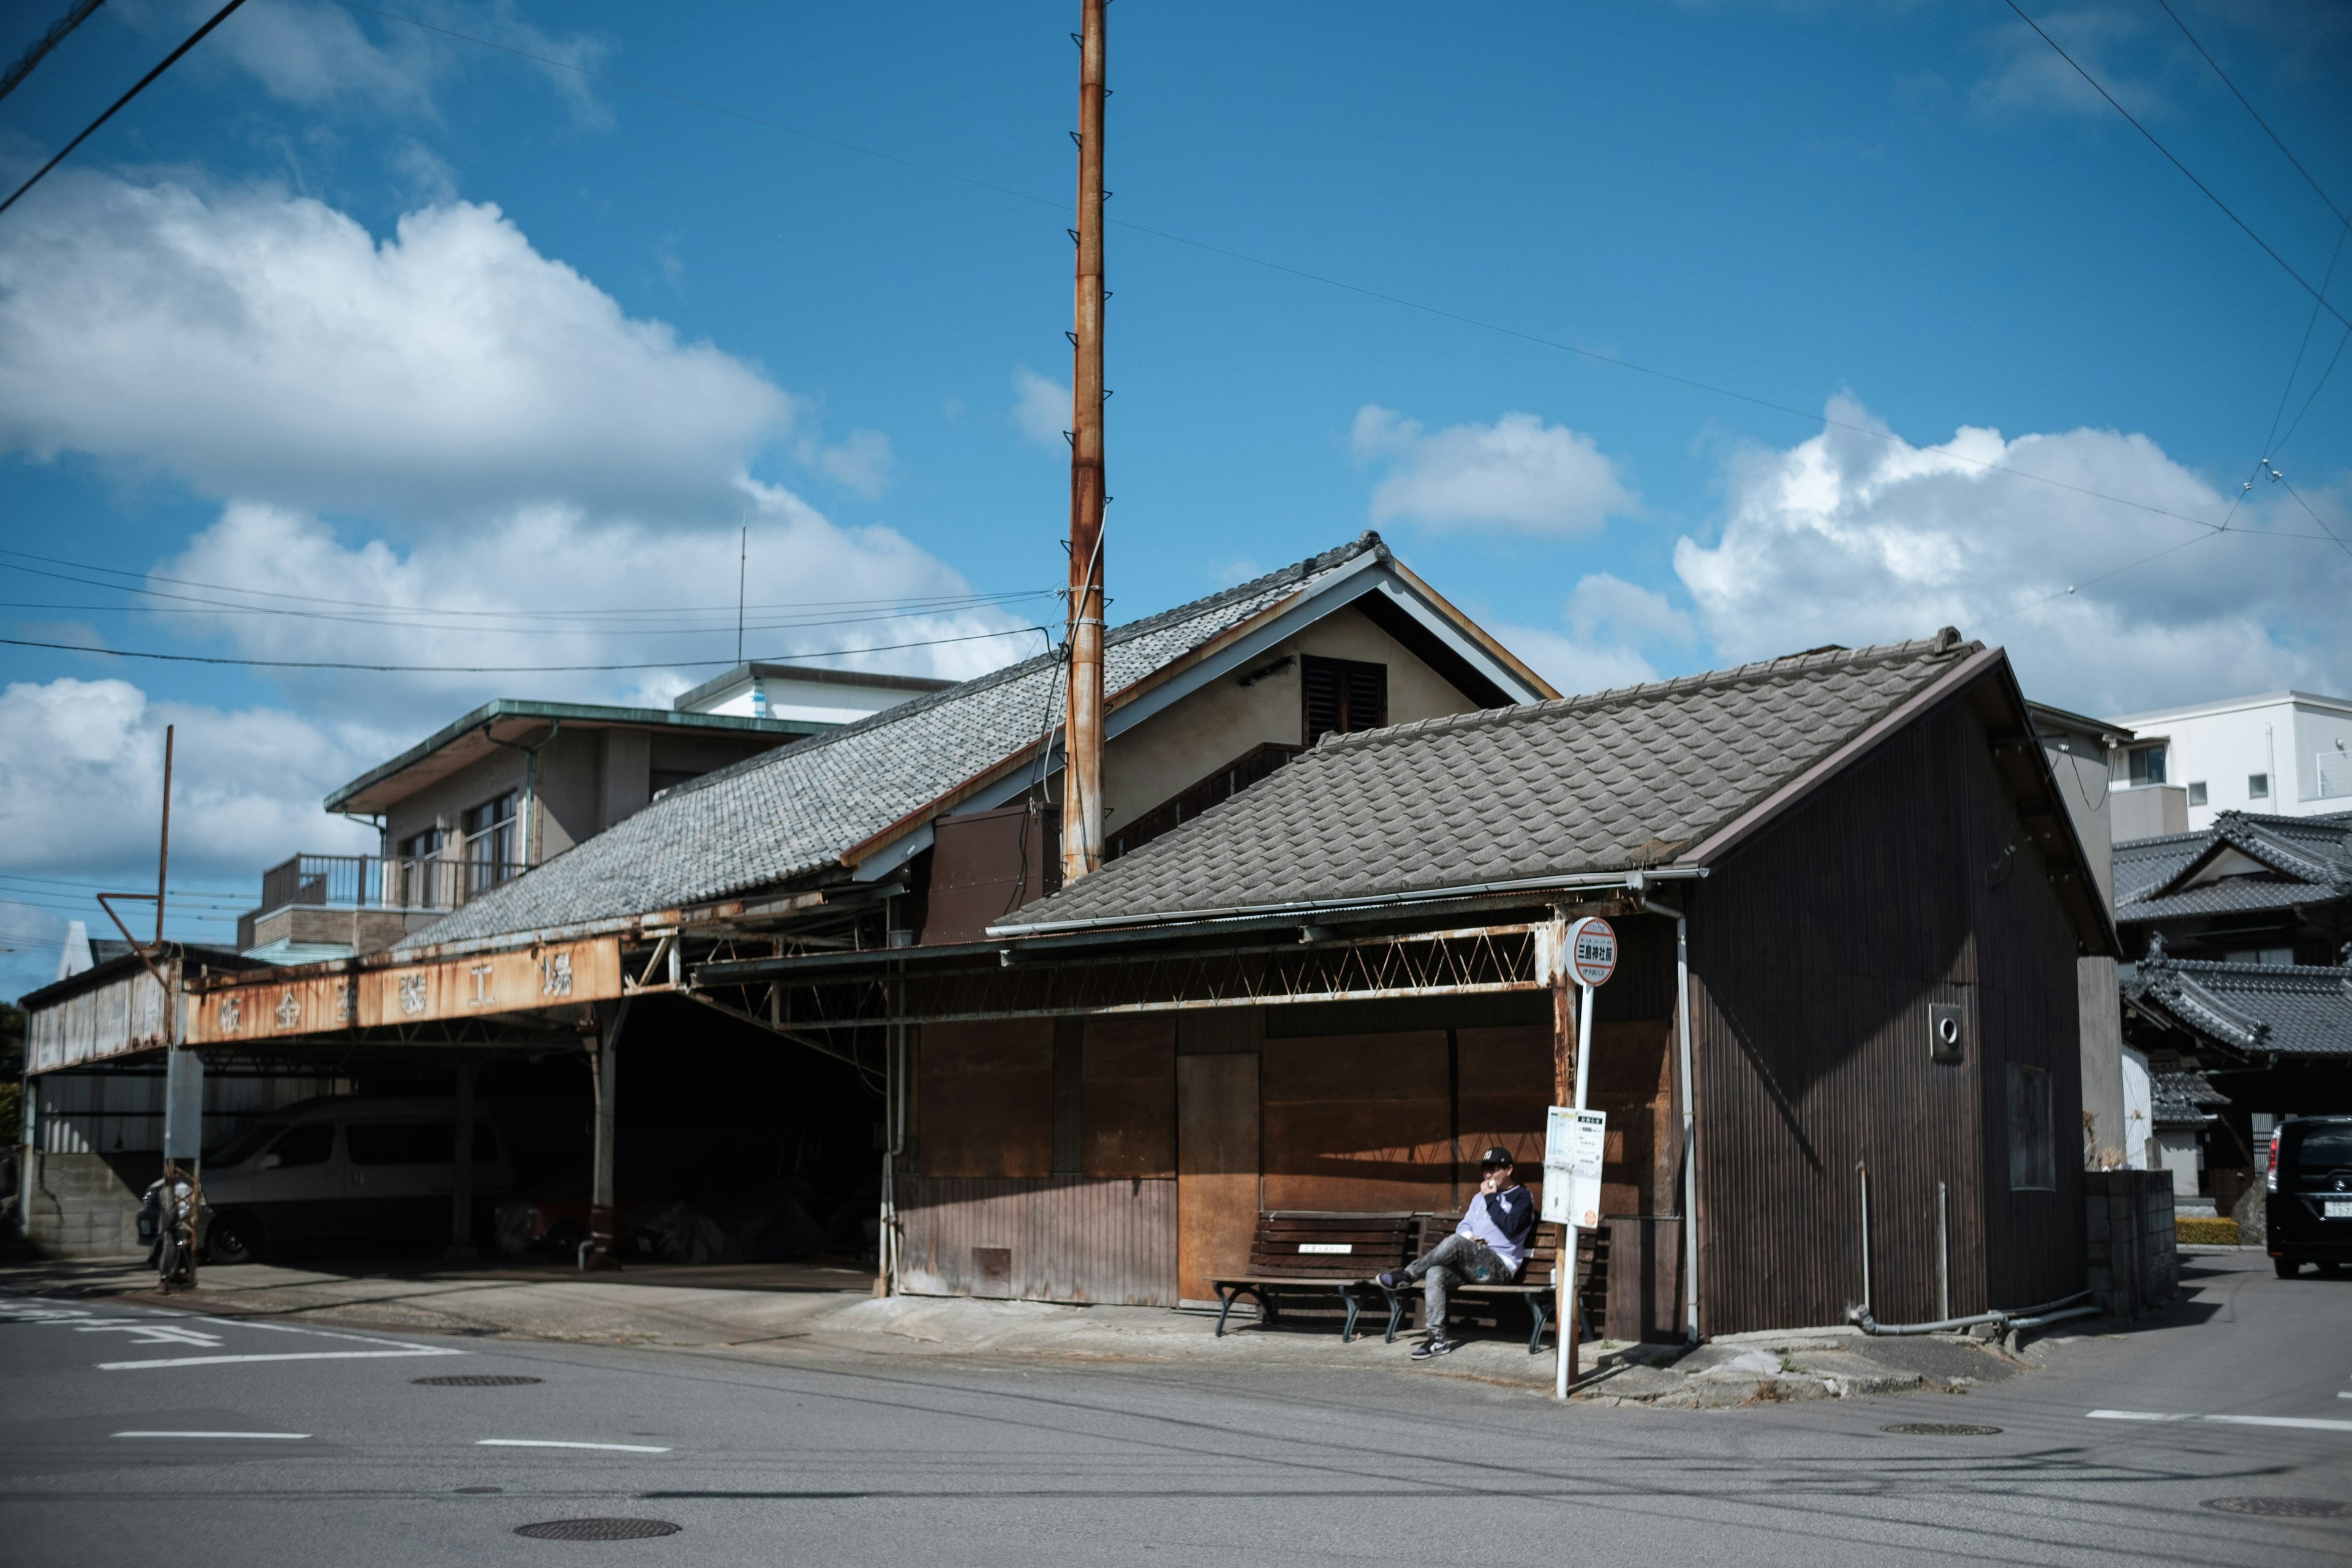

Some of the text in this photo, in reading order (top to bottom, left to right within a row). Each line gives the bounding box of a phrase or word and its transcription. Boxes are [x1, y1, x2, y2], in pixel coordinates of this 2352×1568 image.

[1578, 944, 1612, 962] 三島神社前
